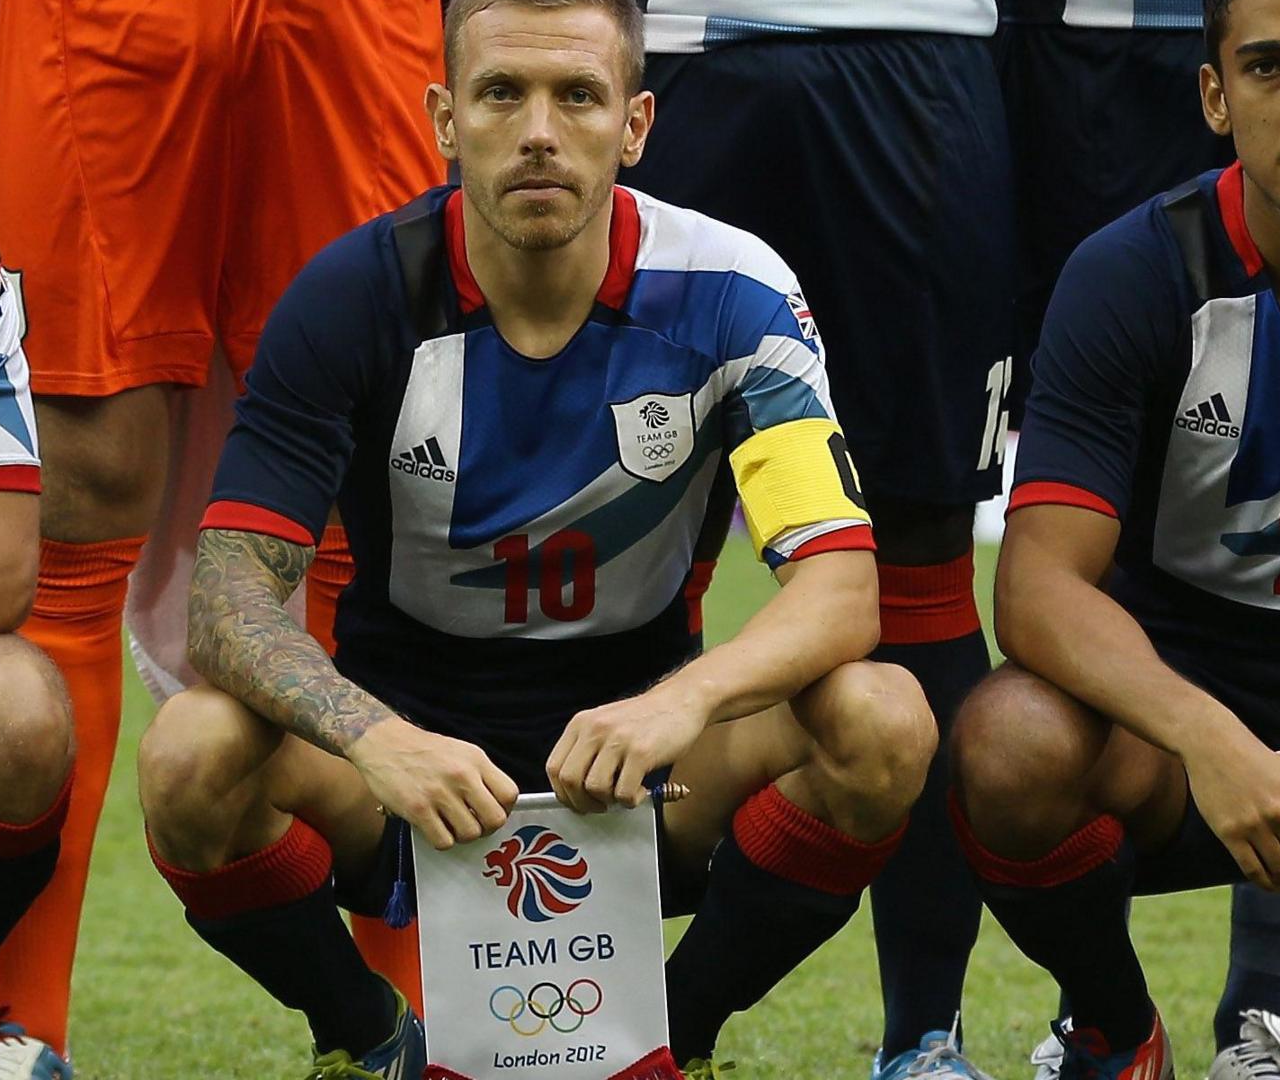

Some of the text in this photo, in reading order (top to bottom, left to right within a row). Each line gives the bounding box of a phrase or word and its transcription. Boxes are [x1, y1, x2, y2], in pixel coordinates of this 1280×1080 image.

[637, 430, 678, 444] TEAM GB
[1175, 416, 1239, 438] adidas
[391, 457, 455, 482] adidas
[494, 529, 595, 624] 10
[469, 933, 615, 970] TEAM GB
[493, 1044, 607, 1068] London 2012
